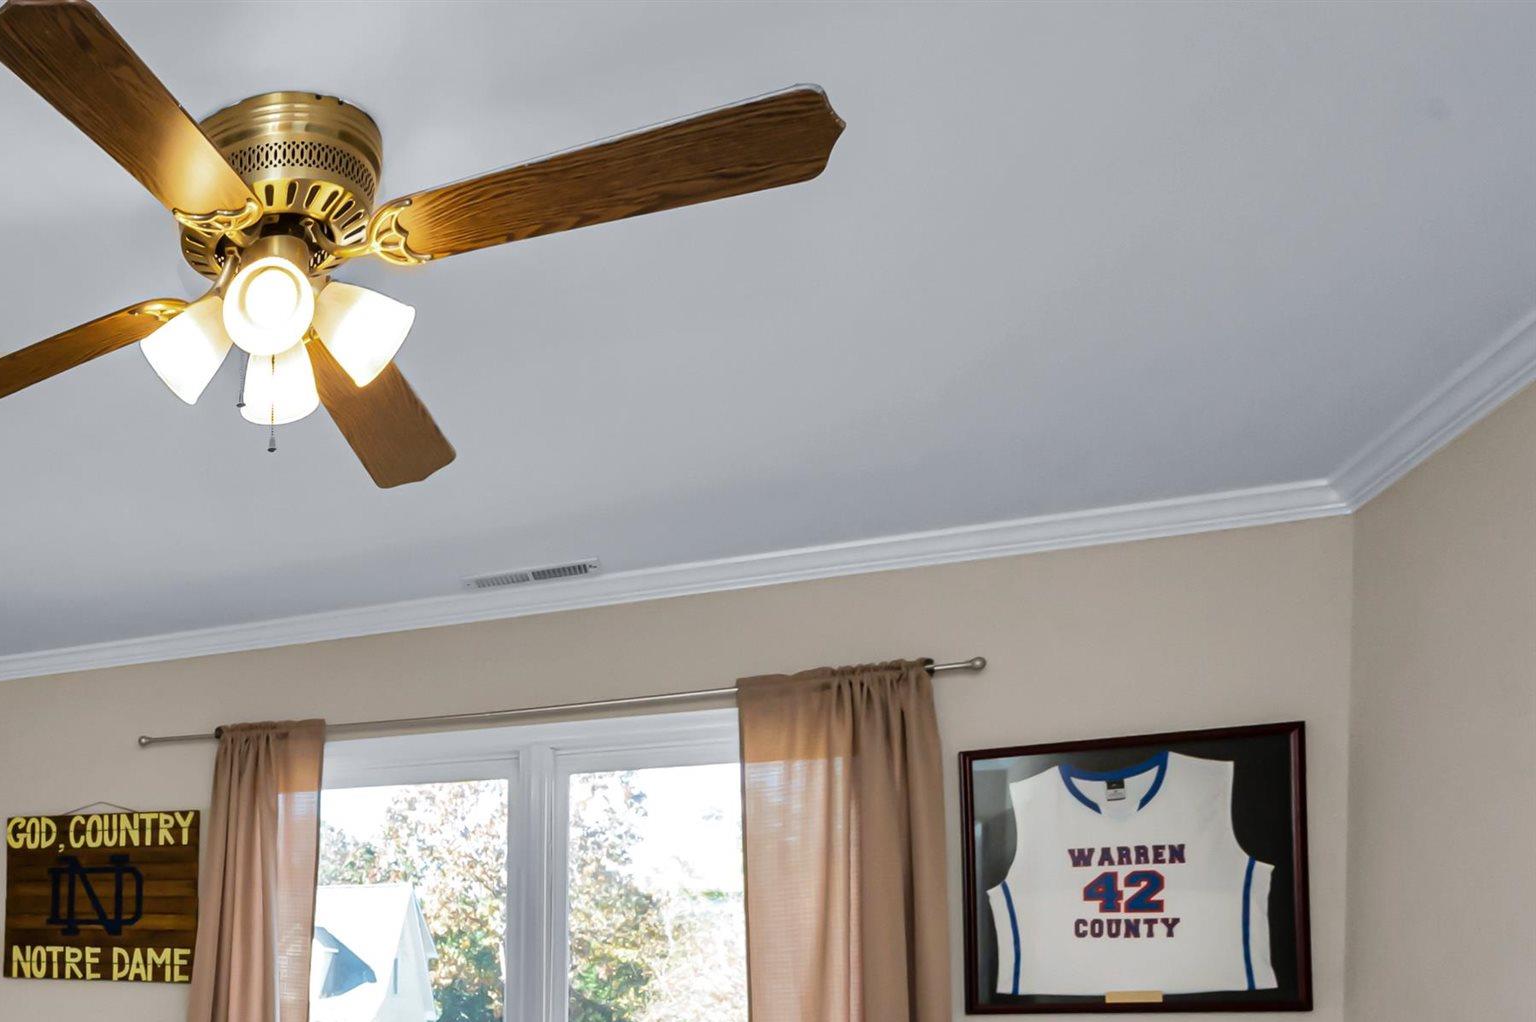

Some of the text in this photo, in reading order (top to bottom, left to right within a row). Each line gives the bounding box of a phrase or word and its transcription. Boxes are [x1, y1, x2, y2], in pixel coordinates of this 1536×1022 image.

[6, 811, 195, 852] GOD, COUNTRY
[1067, 843, 1187, 868] WARREN
[1082, 869, 1165, 914] 42
[1073, 917, 1181, 939] COUNTY
[12, 945, 192, 982] NOTRE DAME
